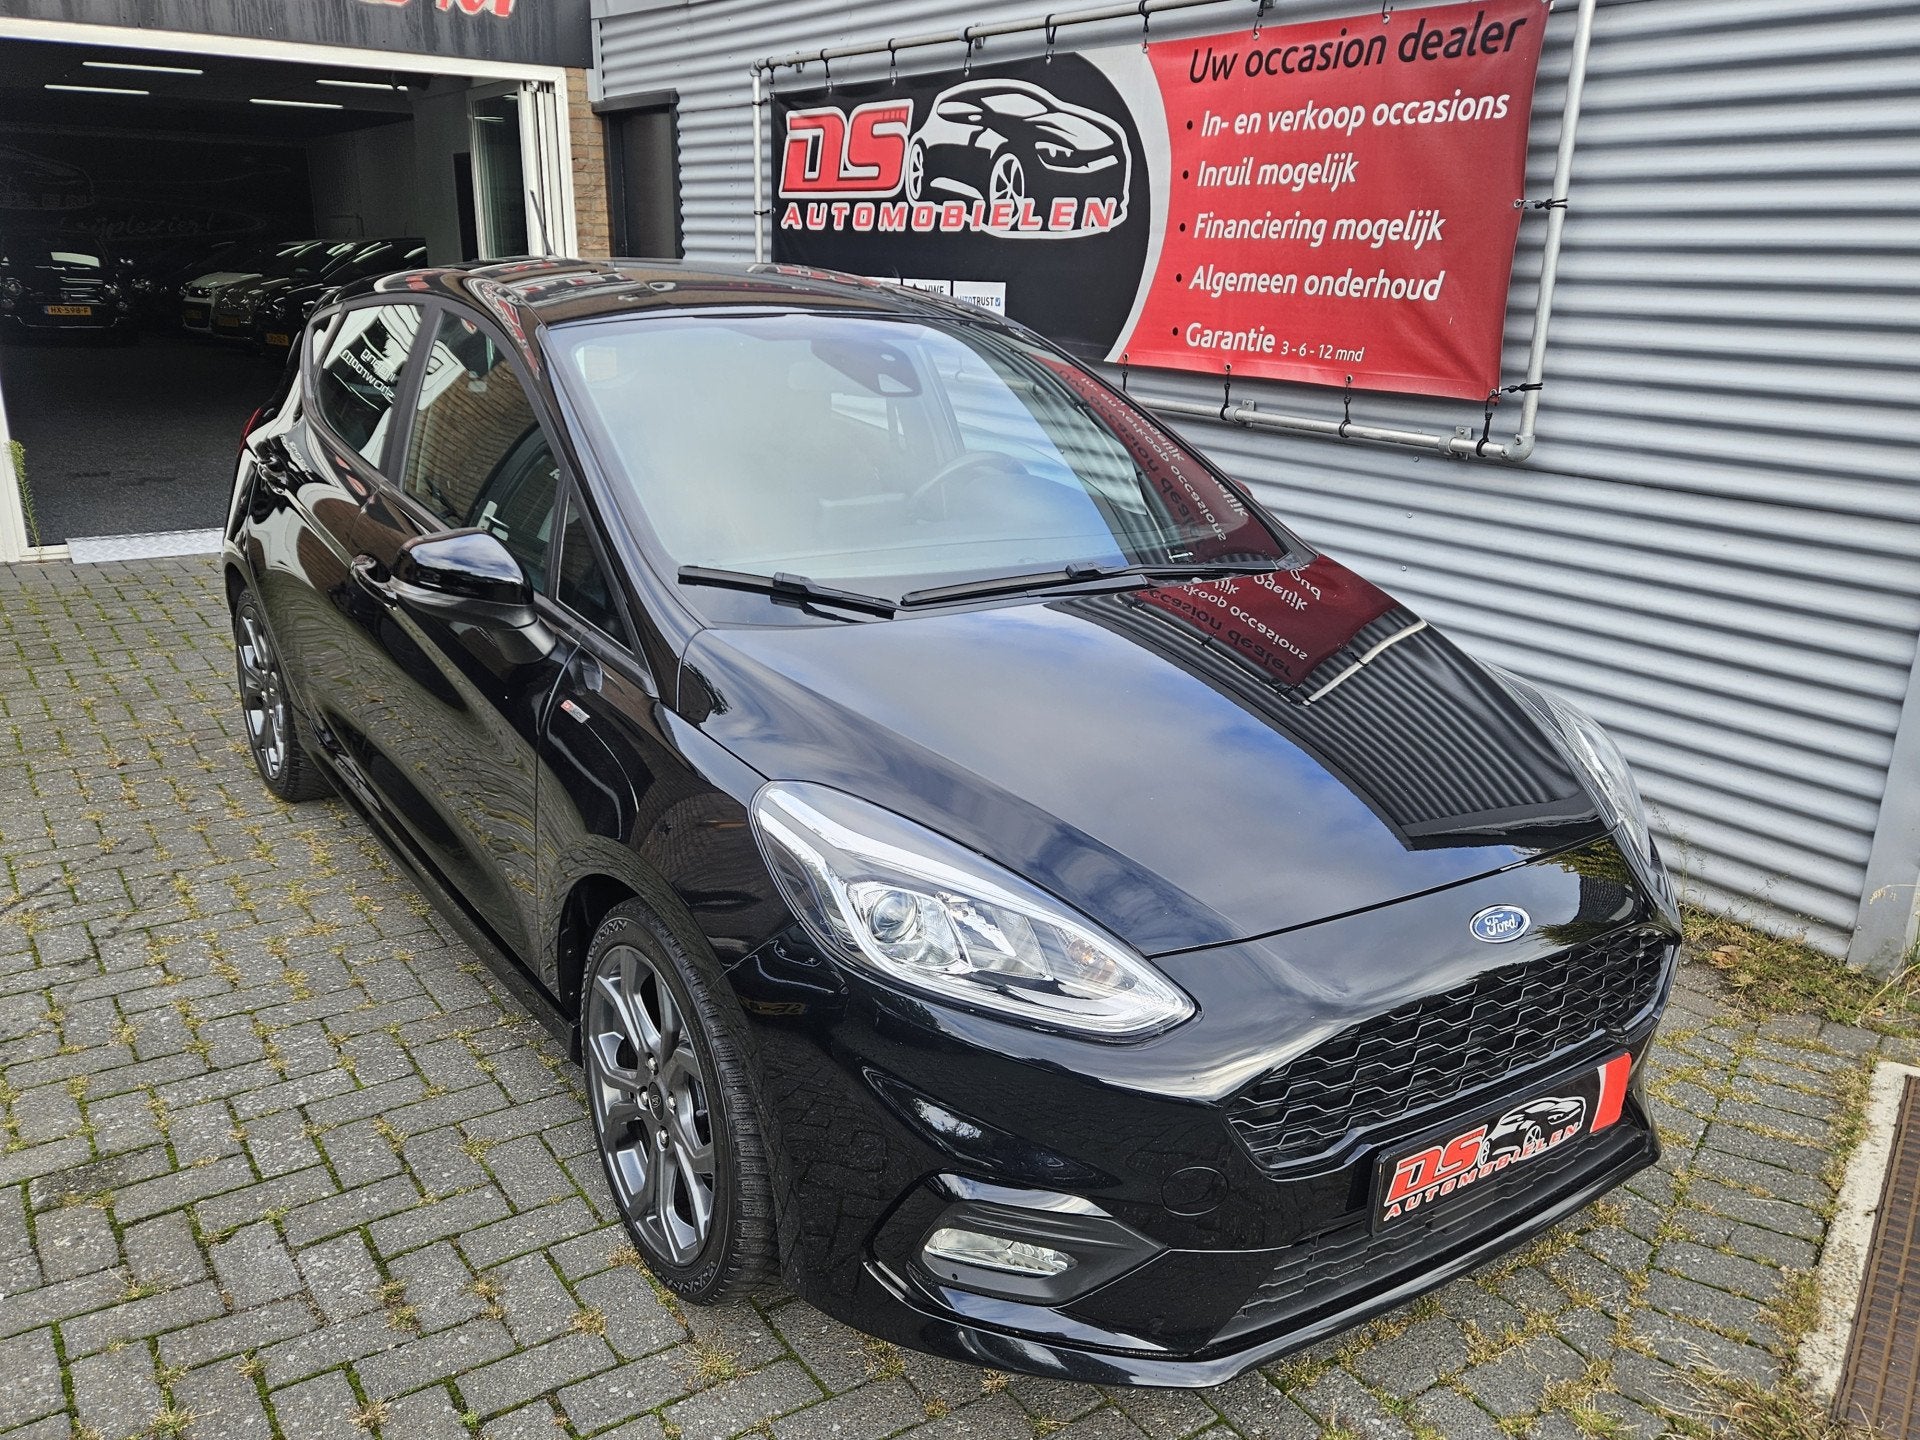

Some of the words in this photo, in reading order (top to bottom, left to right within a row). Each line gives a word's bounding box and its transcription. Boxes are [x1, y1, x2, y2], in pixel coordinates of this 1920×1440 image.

[1188, 47, 1239, 83] Uw
[1245, 27, 1387, 76] occasion
[1397, 10, 1528, 63] dealer
[1201, 110, 1230, 137] In-
[1234, 113, 1261, 135] en
[1267, 100, 1366, 136] verkoop
[1371, 89, 1510, 126] occasions
[779, 98, 914, 198] DS
[1197, 155, 1253, 187] Inruil
[1257, 152, 1359, 192] mogelijk
[781, 197, 1118, 232] AUTOMOBIELEN
[1193, 210, 1328, 247] Financiering
[1332, 209, 1446, 250] mogelijk
[1188, 264, 1298, 298] Algemeen
[1303, 268, 1445, 301] onderhoud
[1185, 322, 1277, 354] Garantie
[1335, 347, 1365, 362] mnd
[1485, 913, 1518, 936] Ford
[1384, 1124, 1488, 1207] DS
[1384, 1121, 1580, 1222] AUTOMOBIELEN
